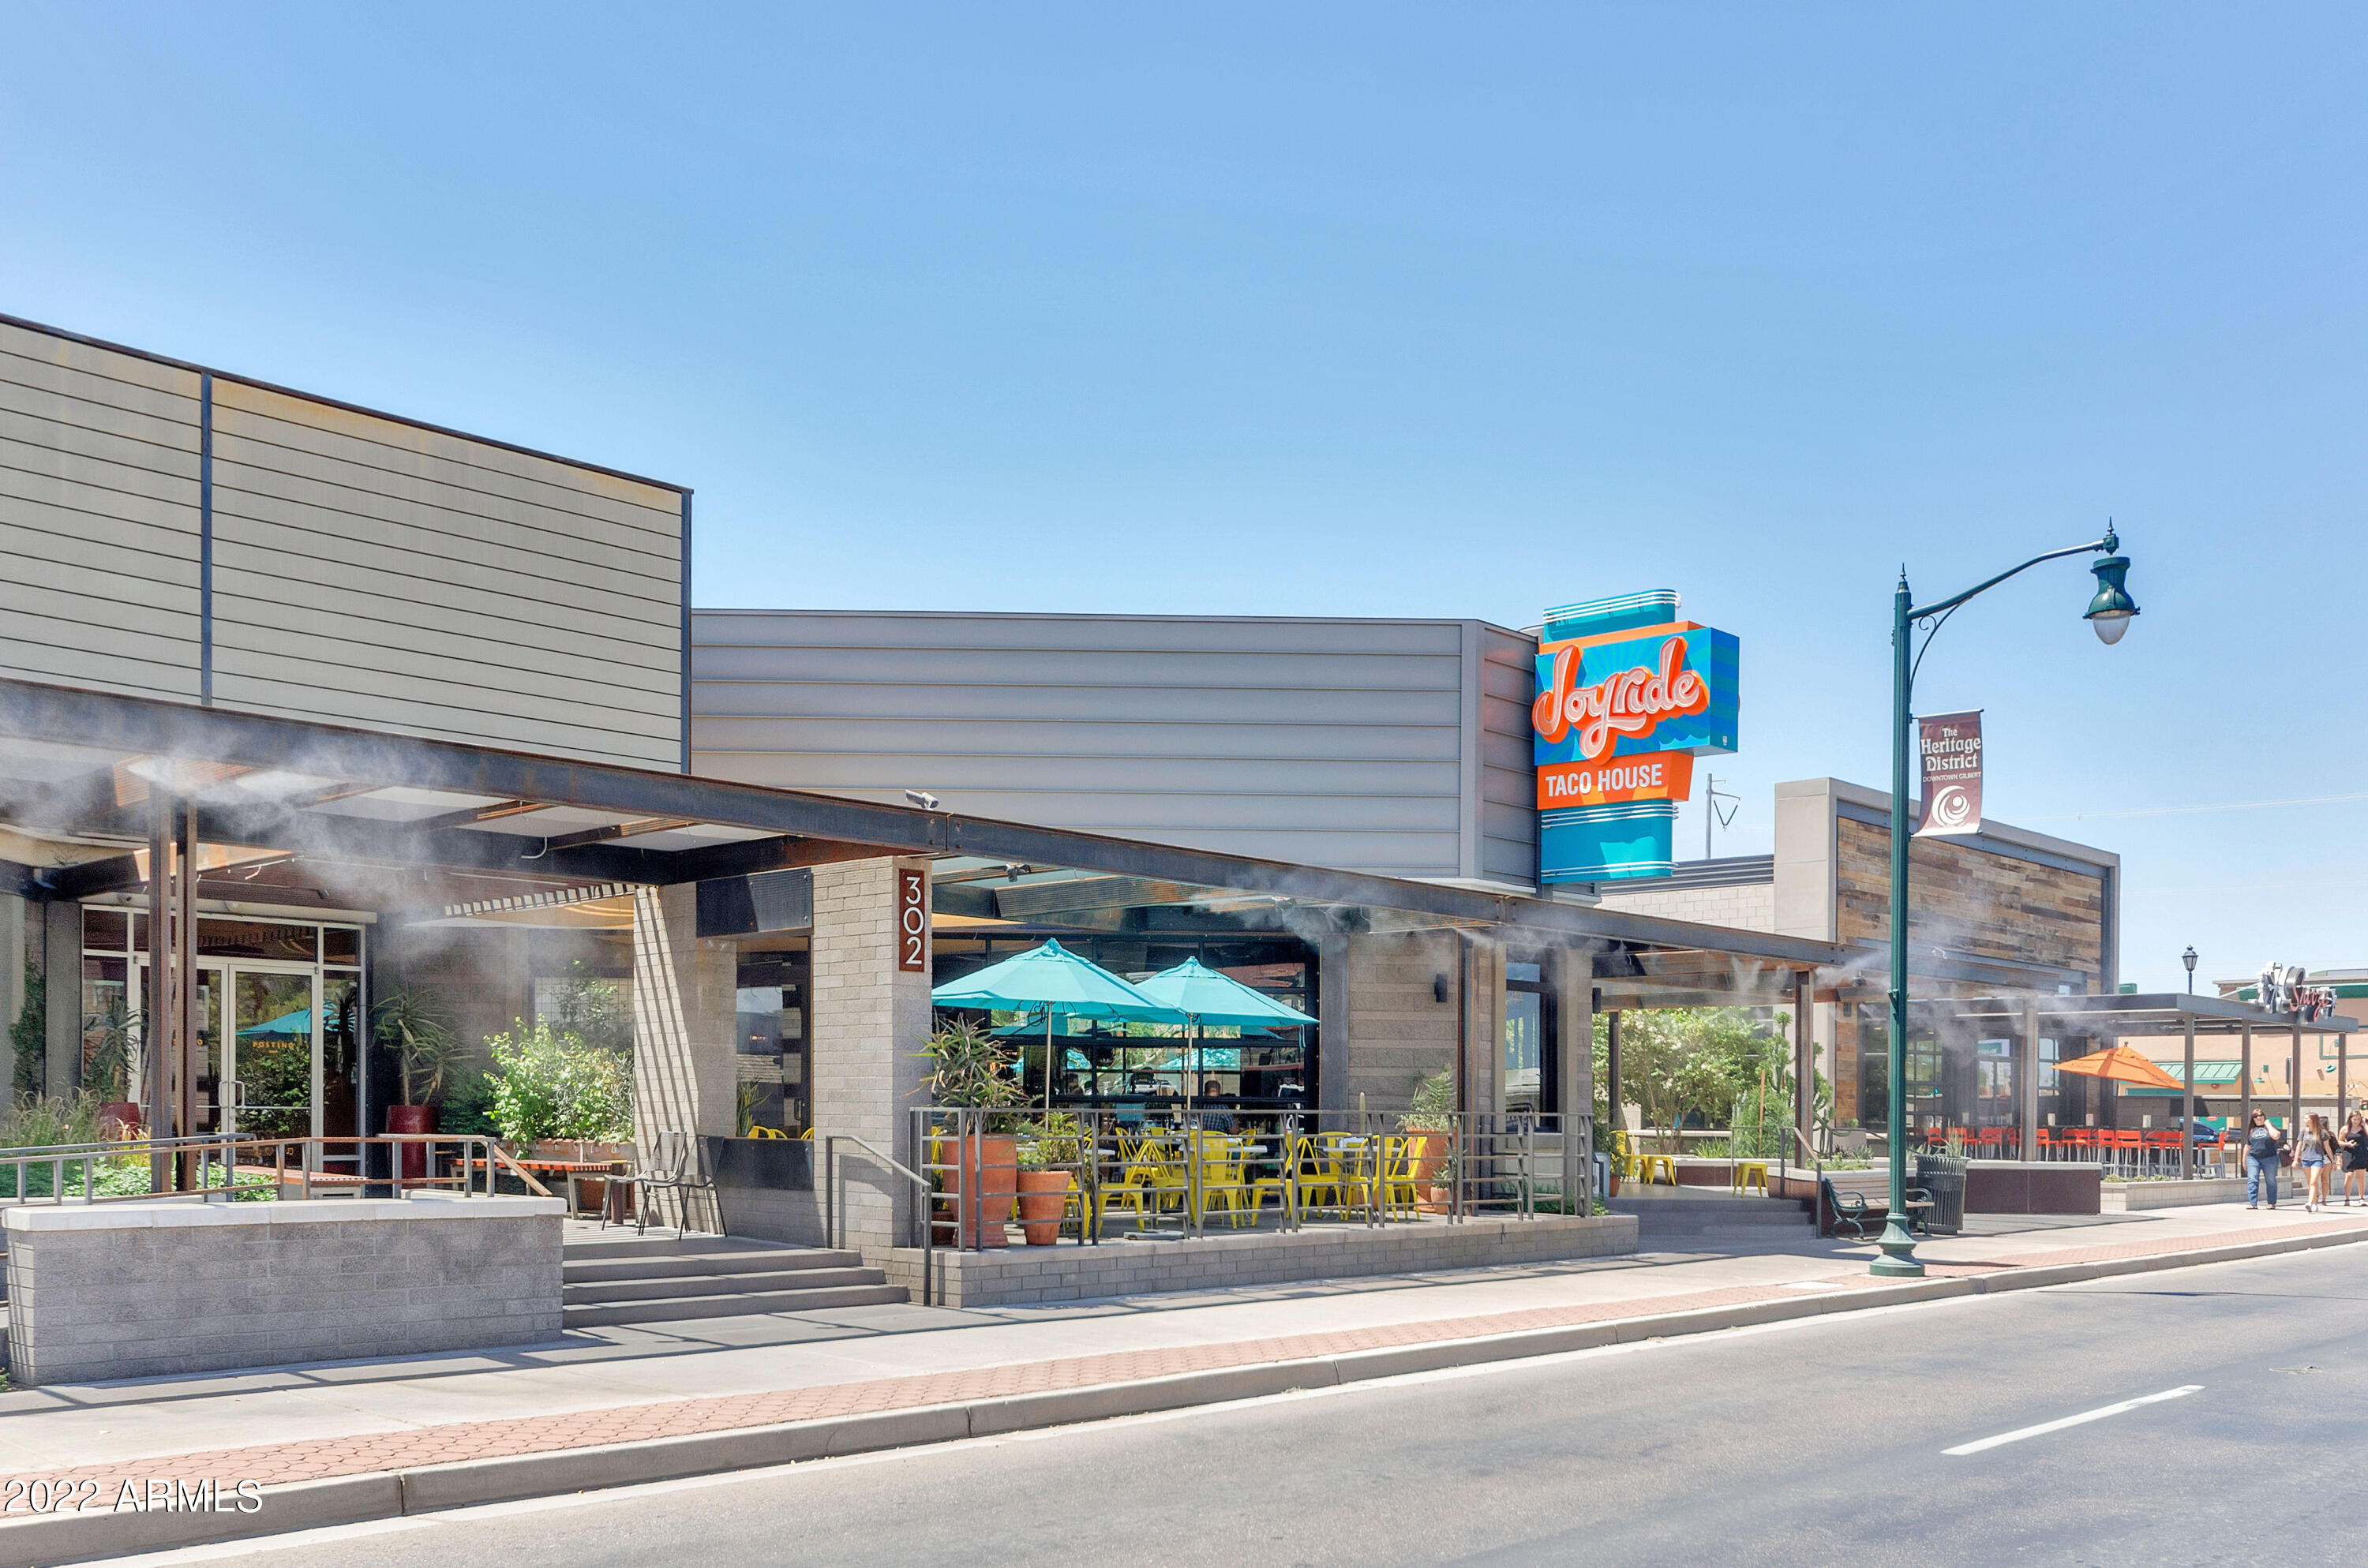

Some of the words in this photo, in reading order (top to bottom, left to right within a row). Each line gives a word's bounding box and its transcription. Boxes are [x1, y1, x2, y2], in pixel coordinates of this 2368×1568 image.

[1532, 636, 1710, 764] Joyride
[1942, 728, 1958, 738] The
[1920, 737, 1982, 755] Heritage
[1925, 753, 1978, 772] District
[1546, 771, 1591, 797] TACO
[1598, 763, 1662, 792] HOUSE
[1922, 774, 1958, 783] DOWNTOWN
[1958, 771, 1982, 780] GILBERT
[903, 876, 924, 965] 302
